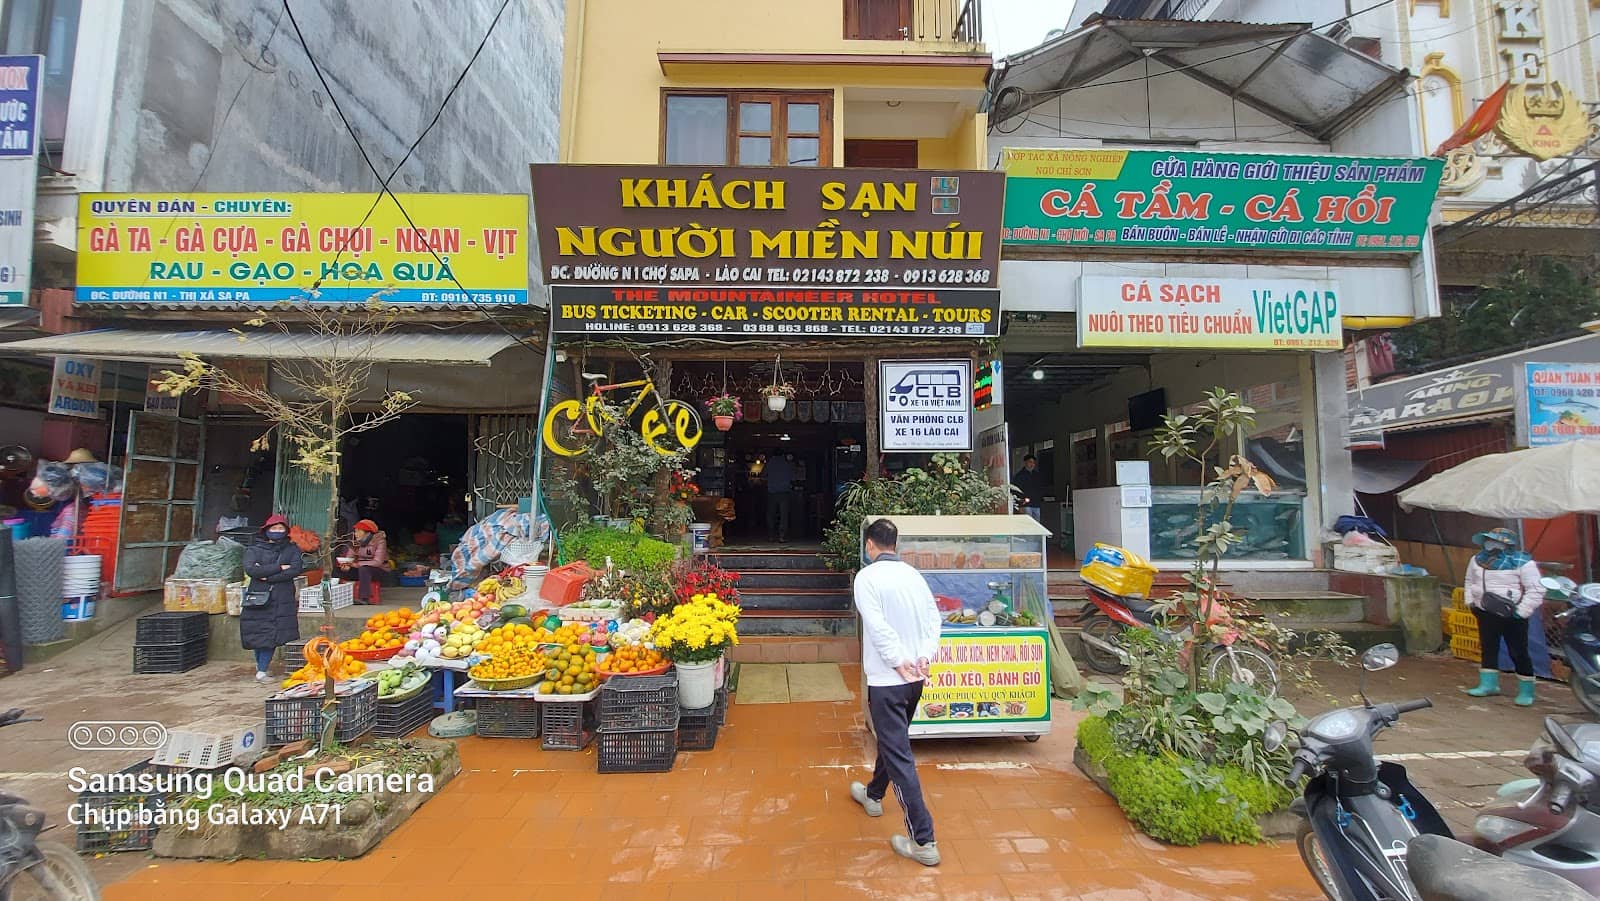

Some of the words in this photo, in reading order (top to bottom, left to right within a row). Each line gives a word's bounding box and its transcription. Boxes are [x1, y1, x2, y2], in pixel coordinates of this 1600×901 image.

[1153, 156, 1187, 176] CỬA
[1192, 158, 1240, 178] HÀNG
[1244, 160, 1279, 179] GIỚI
[1283, 161, 1332, 184] THIỆU
[1335, 161, 1372, 182] SẢN
[620, 173, 786, 210] KHÁCH
[821, 181, 918, 218] SẠN
[1040, 182, 1102, 218] CÁ
[1114, 180, 1212, 219] TẦM
[1244, 188, 1303, 222] CÁ
[1313, 184, 1397, 224] HỒI
[214, 199, 292, 213] CHUYÊN:
[90, 222, 119, 252] GÀ
[127, 228, 152, 252] TA
[175, 222, 205, 252] GÀ
[212, 225, 258, 258] CỰA
[281, 222, 312, 252] GÀ
[319, 227, 372, 258] CHỌI
[395, 228, 460, 253] NGAN
[483, 229, 518, 260] VỊT
[555, 222, 736, 259] NGƯỜI
[749, 218, 879, 260] MIỀN
[889, 222, 983, 260] NÚI
[1122, 225, 1146, 241] BÁN
[1147, 226, 1179, 241] BUÔN
[1188, 226, 1212, 242] BÁN
[151, 262, 203, 280] RAU
[229, 262, 294, 286] GẠO
[321, 262, 384, 280] HOA
[392, 257, 456, 281] QUẢ
[574, 262, 619, 280] ĐƯỜNG
[641, 263, 668, 284] CHỢ
[670, 267, 700, 281] SAPA
[715, 264, 740, 281] LÀO
[743, 267, 763, 281] CAI
[767, 268, 790, 282] TEL:
[864, 270, 889, 283] 238
[218, 291, 232, 301] SA
[235, 291, 250, 301] PA
[472, 294, 492, 303] 735
[495, 294, 516, 303] 910
[612, 289, 659, 303] THE
[668, 289, 854, 304] MOUNTAINEER
[862, 291, 942, 304] HOTEL
[1121, 280, 1152, 302] CÁ
[1159, 284, 1221, 307] SẠCH
[561, 304, 597, 320] BUS
[600, 305, 698, 320] TICKETING
[711, 306, 748, 320] CAR
[762, 306, 843, 321] SCOOTER
[847, 307, 919, 322] RENTAL
[932, 308, 992, 323] TOURS
[1252, 289, 1338, 335] VietGAP
[585, 322, 635, 332] HOLINE:
[638, 323, 669, 332] 0913
[673, 323, 697, 332] 628
[700, 323, 723, 332] 368
[840, 325, 866, 333] TEL:
[870, 325, 909, 334] 02143
[911, 325, 935, 334] 872
[938, 326, 961, 334] 238
[1088, 311, 1124, 333] NUÔI
[1127, 314, 1165, 333] THEO
[1168, 312, 1200, 333] TIÊU
[1204, 309, 1252, 334] CHUẨN
[65, 360, 96, 378] OXY
[916, 386, 962, 398] CLB
[910, 399, 920, 407] XE
[946, 399, 960, 407] NAM
[947, 415, 964, 424] CLB
[895, 427, 907, 437] XE
[910, 427, 921, 437] 16
[943, 427, 959, 437] CAI
[938, 670, 956, 687] XÔI
[988, 669, 1019, 686] BÁNH
